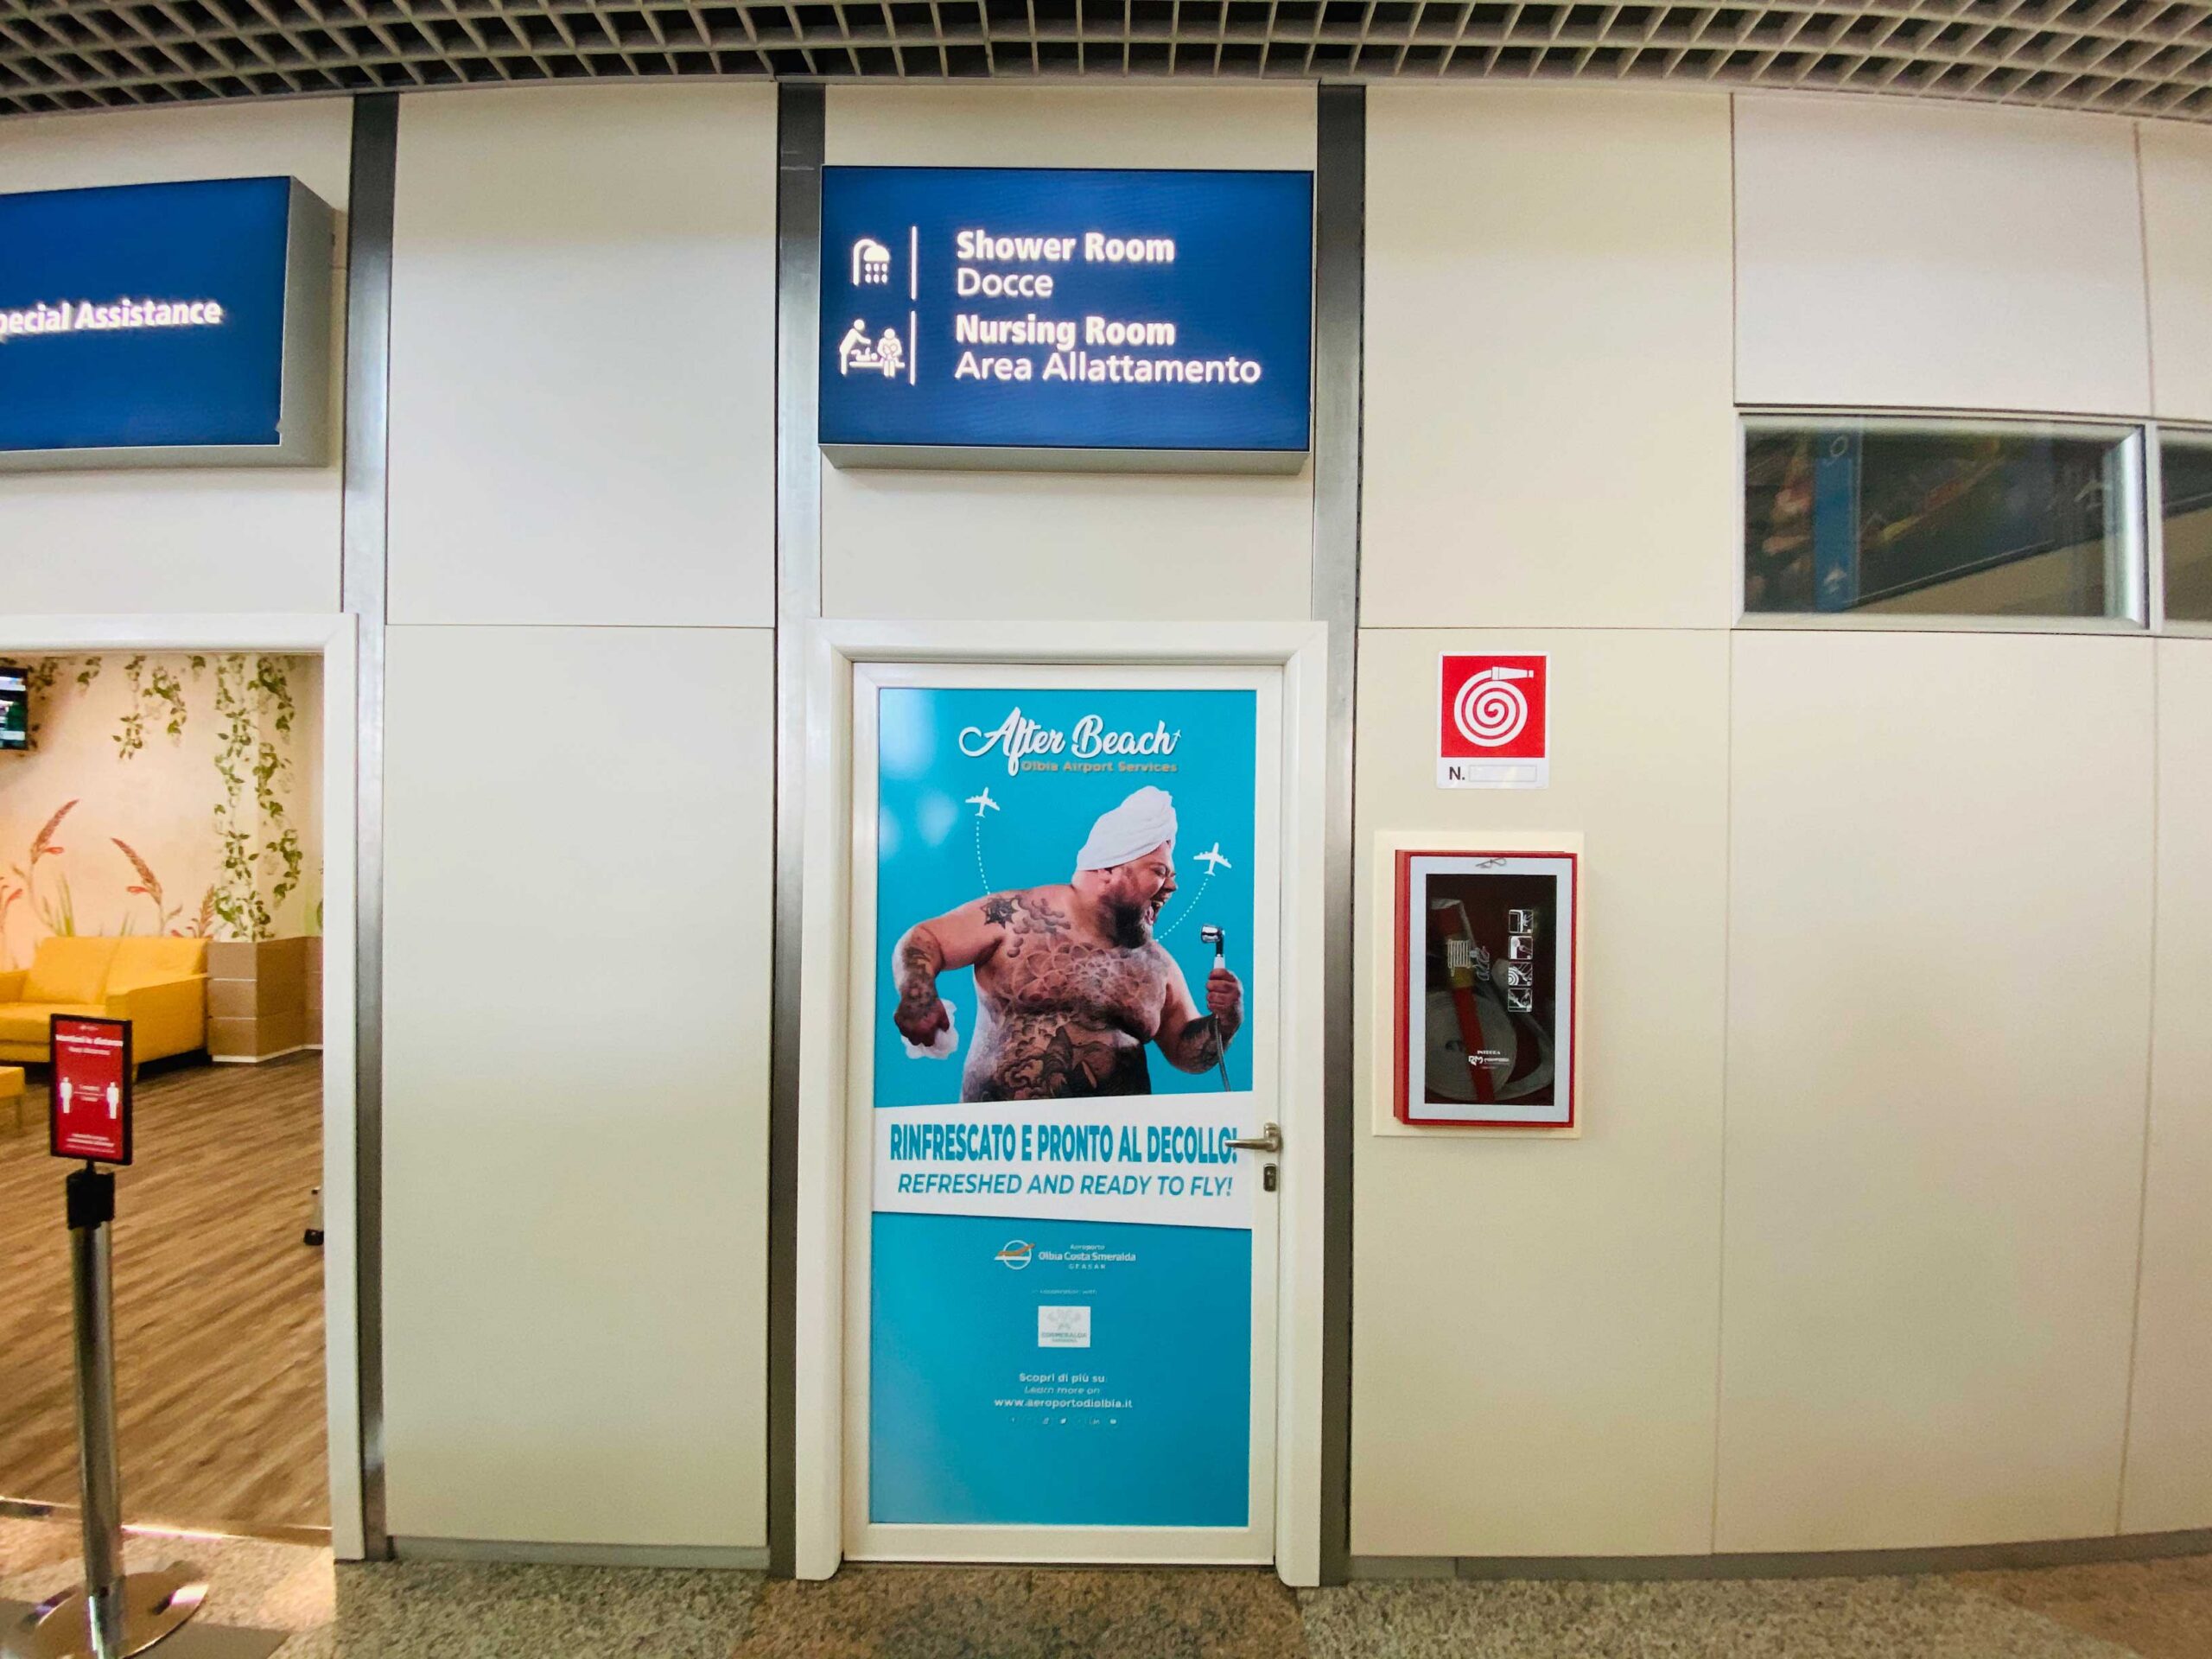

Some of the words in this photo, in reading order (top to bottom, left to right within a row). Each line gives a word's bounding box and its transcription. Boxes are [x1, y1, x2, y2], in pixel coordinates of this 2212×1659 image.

[957, 230, 1077, 262] Shower
[1084, 232, 1175, 263] Room
[957, 268, 1054, 299] Docce
[74, 298, 223, 330] Assistance
[956, 314, 1077, 350] Nursing
[1084, 316, 1175, 346] Room
[954, 351, 1033, 381] Area
[1042, 352, 1262, 384] Allattamento
[958, 706, 1066, 777] After
[1071, 714, 1178, 759] Beach
[1021, 760, 1058, 772] Olbia
[1063, 761, 1114, 773] Airport
[1118, 761, 1178, 772] Services
[1448, 766, 1465, 781] N.
[890, 1123, 1014, 1162] RINFRESCATO
[1022, 1125, 1032, 1161] E
[1038, 1124, 1114, 1163] PRONTO
[1118, 1126, 1142, 1163] AL
[1147, 1126, 1237, 1165] DECOLLO!
[898, 1173, 1020, 1194] REFRESHED
[1027, 1174, 1075, 1194] AND
[1080, 1175, 1152, 1196] READY
[1157, 1175, 1185, 1196] TO
[1190, 1176, 1233, 1197] FLY!
[1038, 1251, 1063, 1260] Olbia
[1064, 1252, 1090, 1261] Costa
[1091, 1252, 1136, 1262] Smeralda
[1019, 1373, 1055, 1383] Scopri
[1058, 1374, 1068, 1382] di
